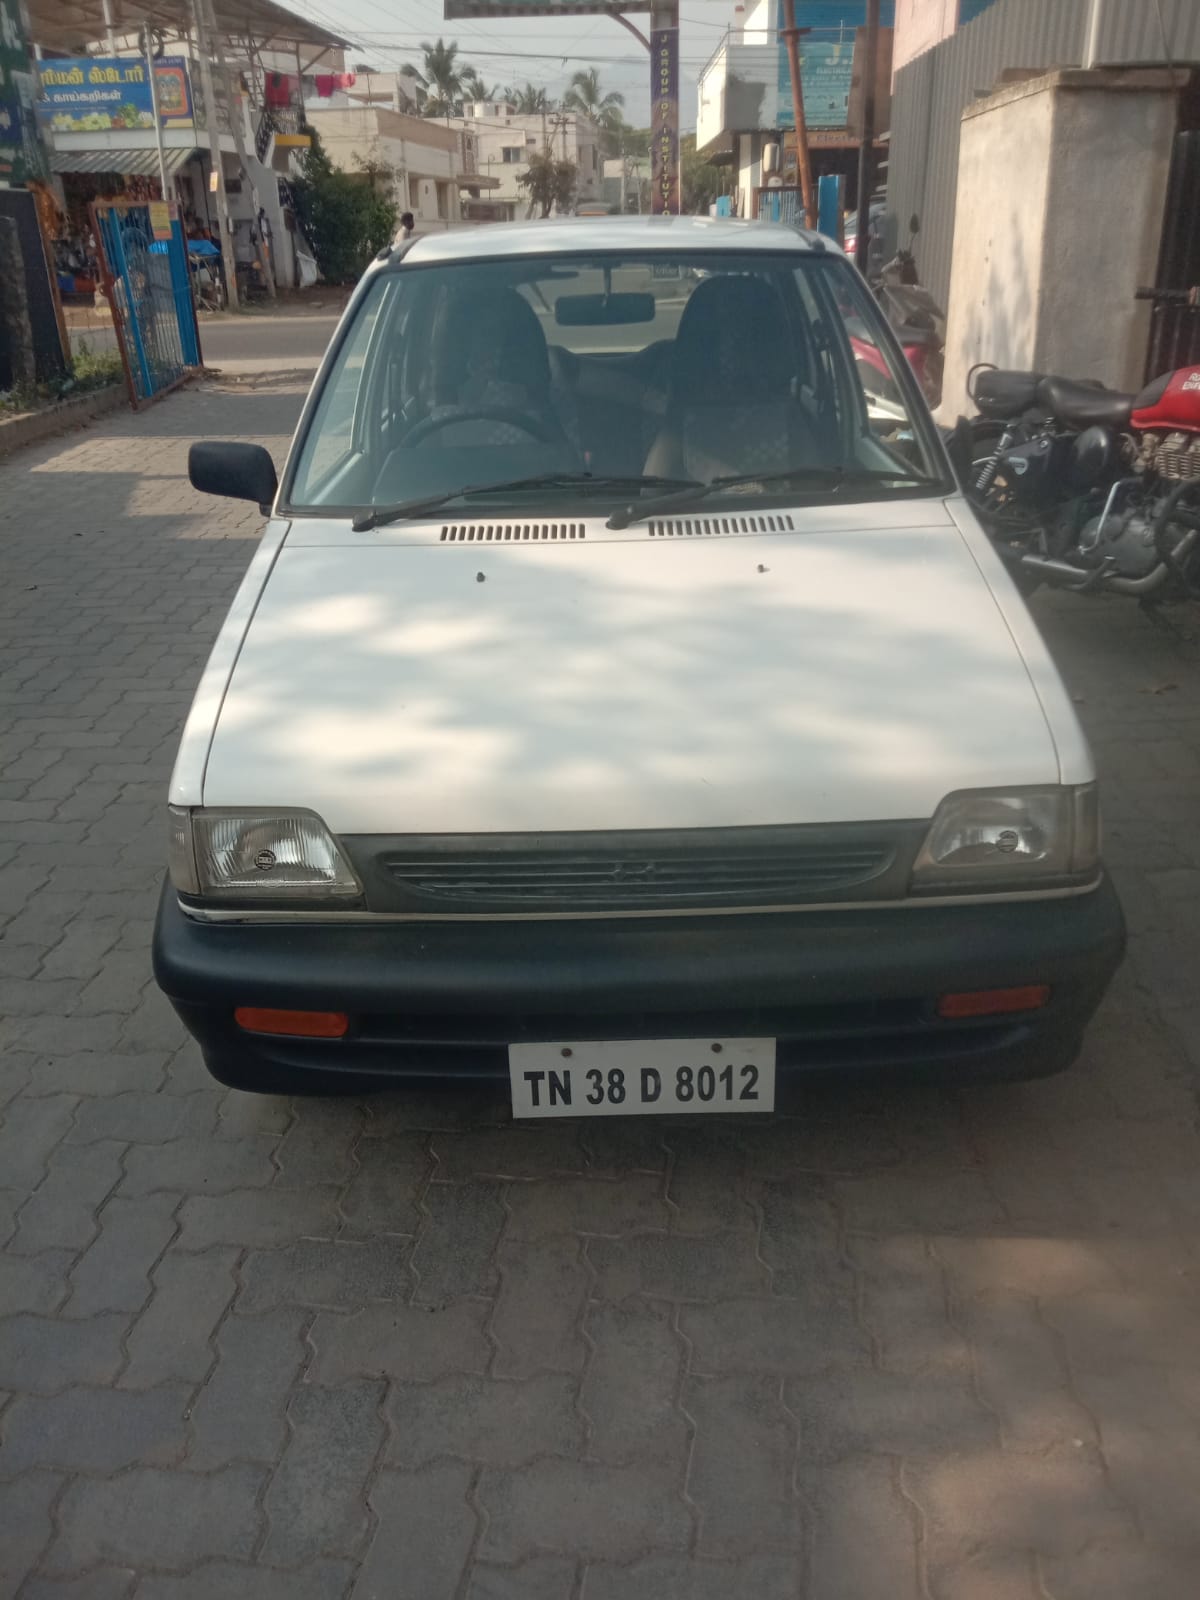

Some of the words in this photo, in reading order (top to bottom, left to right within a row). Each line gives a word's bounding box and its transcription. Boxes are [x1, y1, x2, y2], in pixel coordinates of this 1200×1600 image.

[88, 65, 144, 84] ஸ்டோர்
[660, 49, 669, 94] GROUP
[660, 103, 669, 119] OF
[523, 1070, 572, 1106] TN
[585, 1068, 626, 1104] 38
[640, 1067, 661, 1102] D
[676, 1064, 760, 1102] 8012
